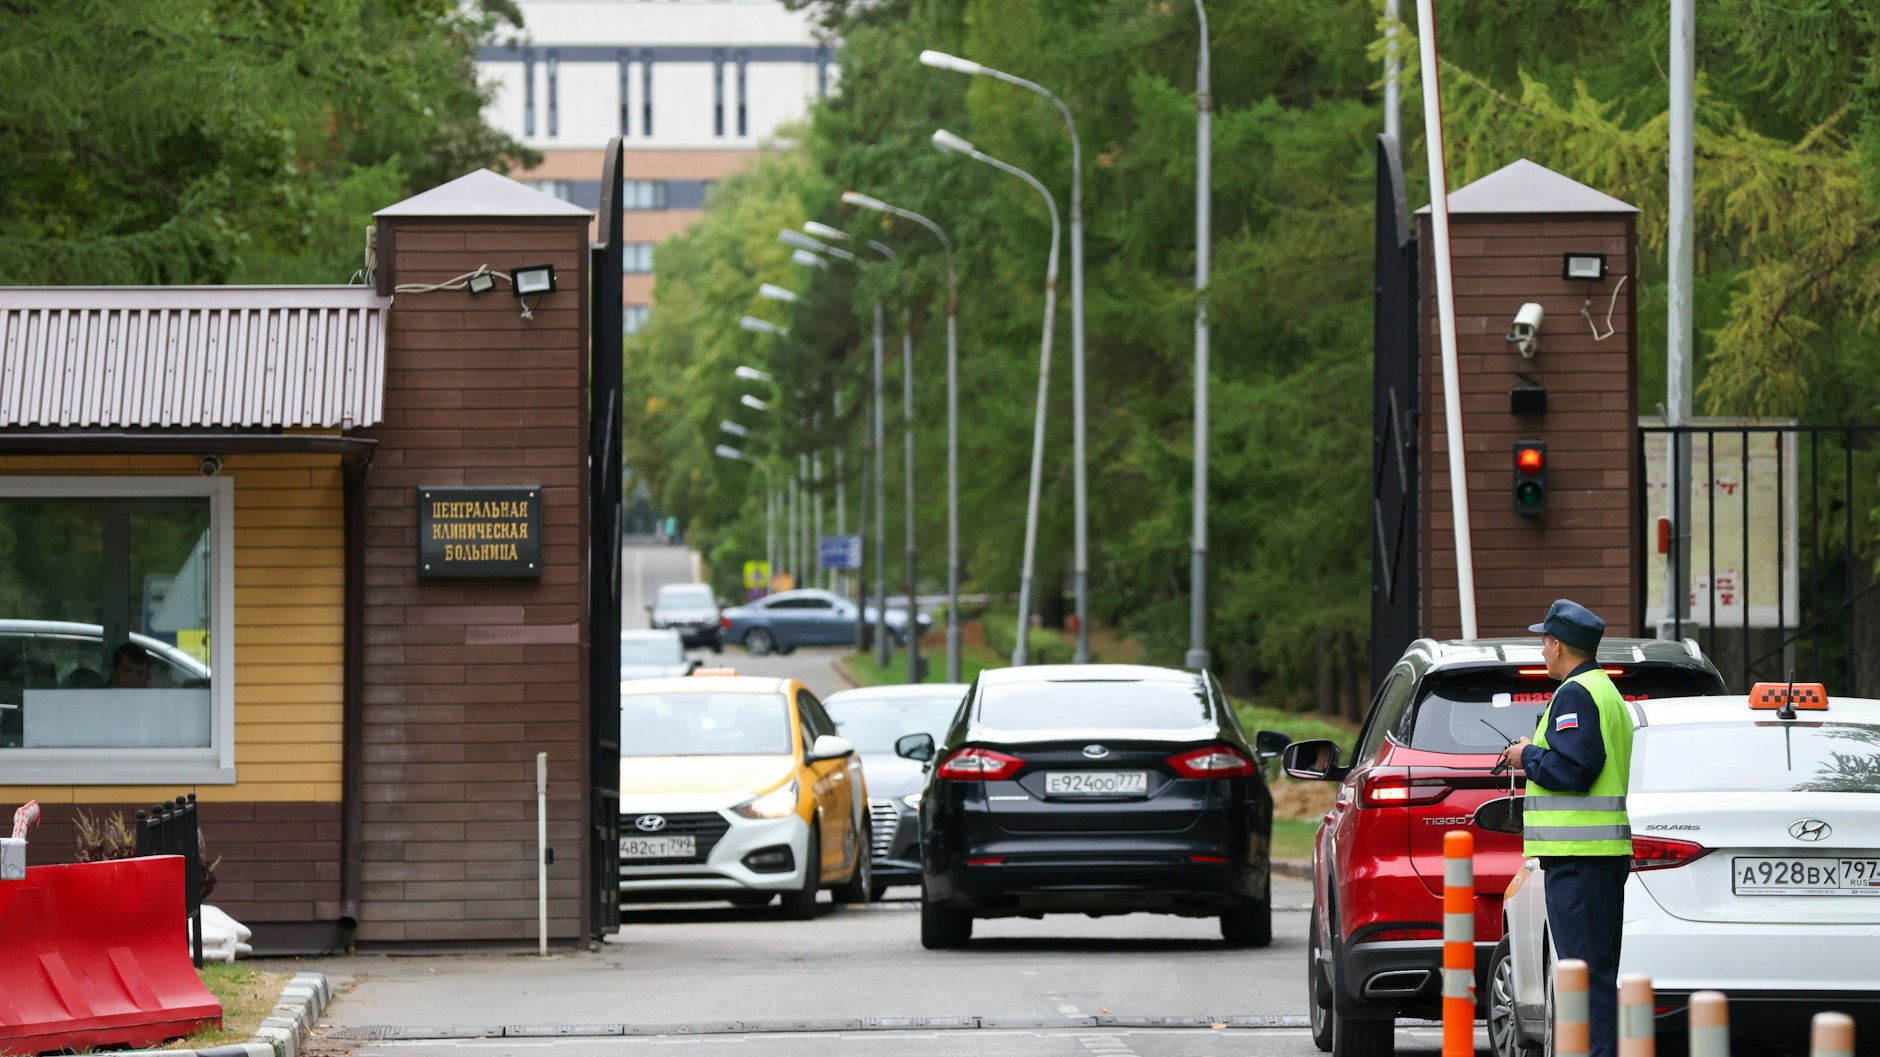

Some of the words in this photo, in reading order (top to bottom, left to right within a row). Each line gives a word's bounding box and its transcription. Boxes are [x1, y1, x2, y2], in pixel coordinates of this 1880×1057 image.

[432, 501, 528, 519] ЦЕНТРАЛЬНАЯ
[432, 522, 528, 539] КЛИНИЧЕСКАЯ
[444, 543, 518, 561] БОЛЬНИЦА
[1119, 774, 1141, 785] 777
[619, 840, 666, 855] 482СТ
[670, 838, 691, 849] 799
[1841, 861, 1878, 879] 797
